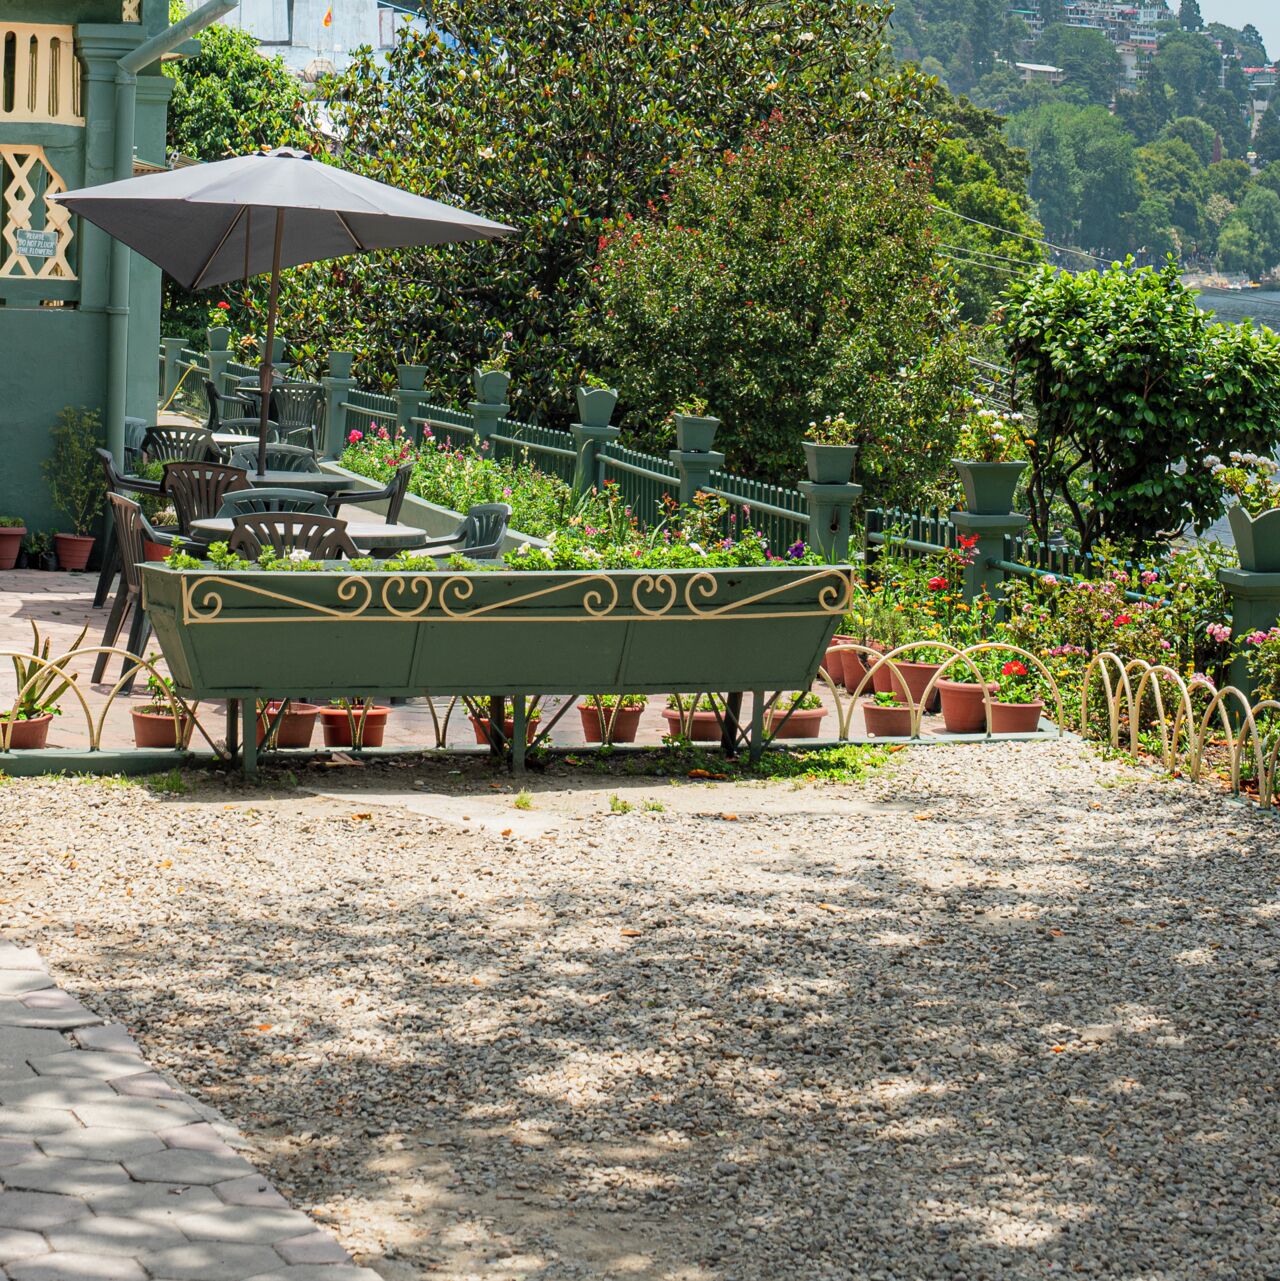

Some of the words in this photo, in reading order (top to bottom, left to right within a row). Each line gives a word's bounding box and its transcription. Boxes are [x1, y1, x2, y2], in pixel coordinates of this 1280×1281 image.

[26, 232, 45, 240] PLEASE
[19, 239, 27, 247] DO
[27, 240, 38, 248] NOT
[18, 246, 28, 254] THE
[30, 247, 54, 256] FLOWERS
